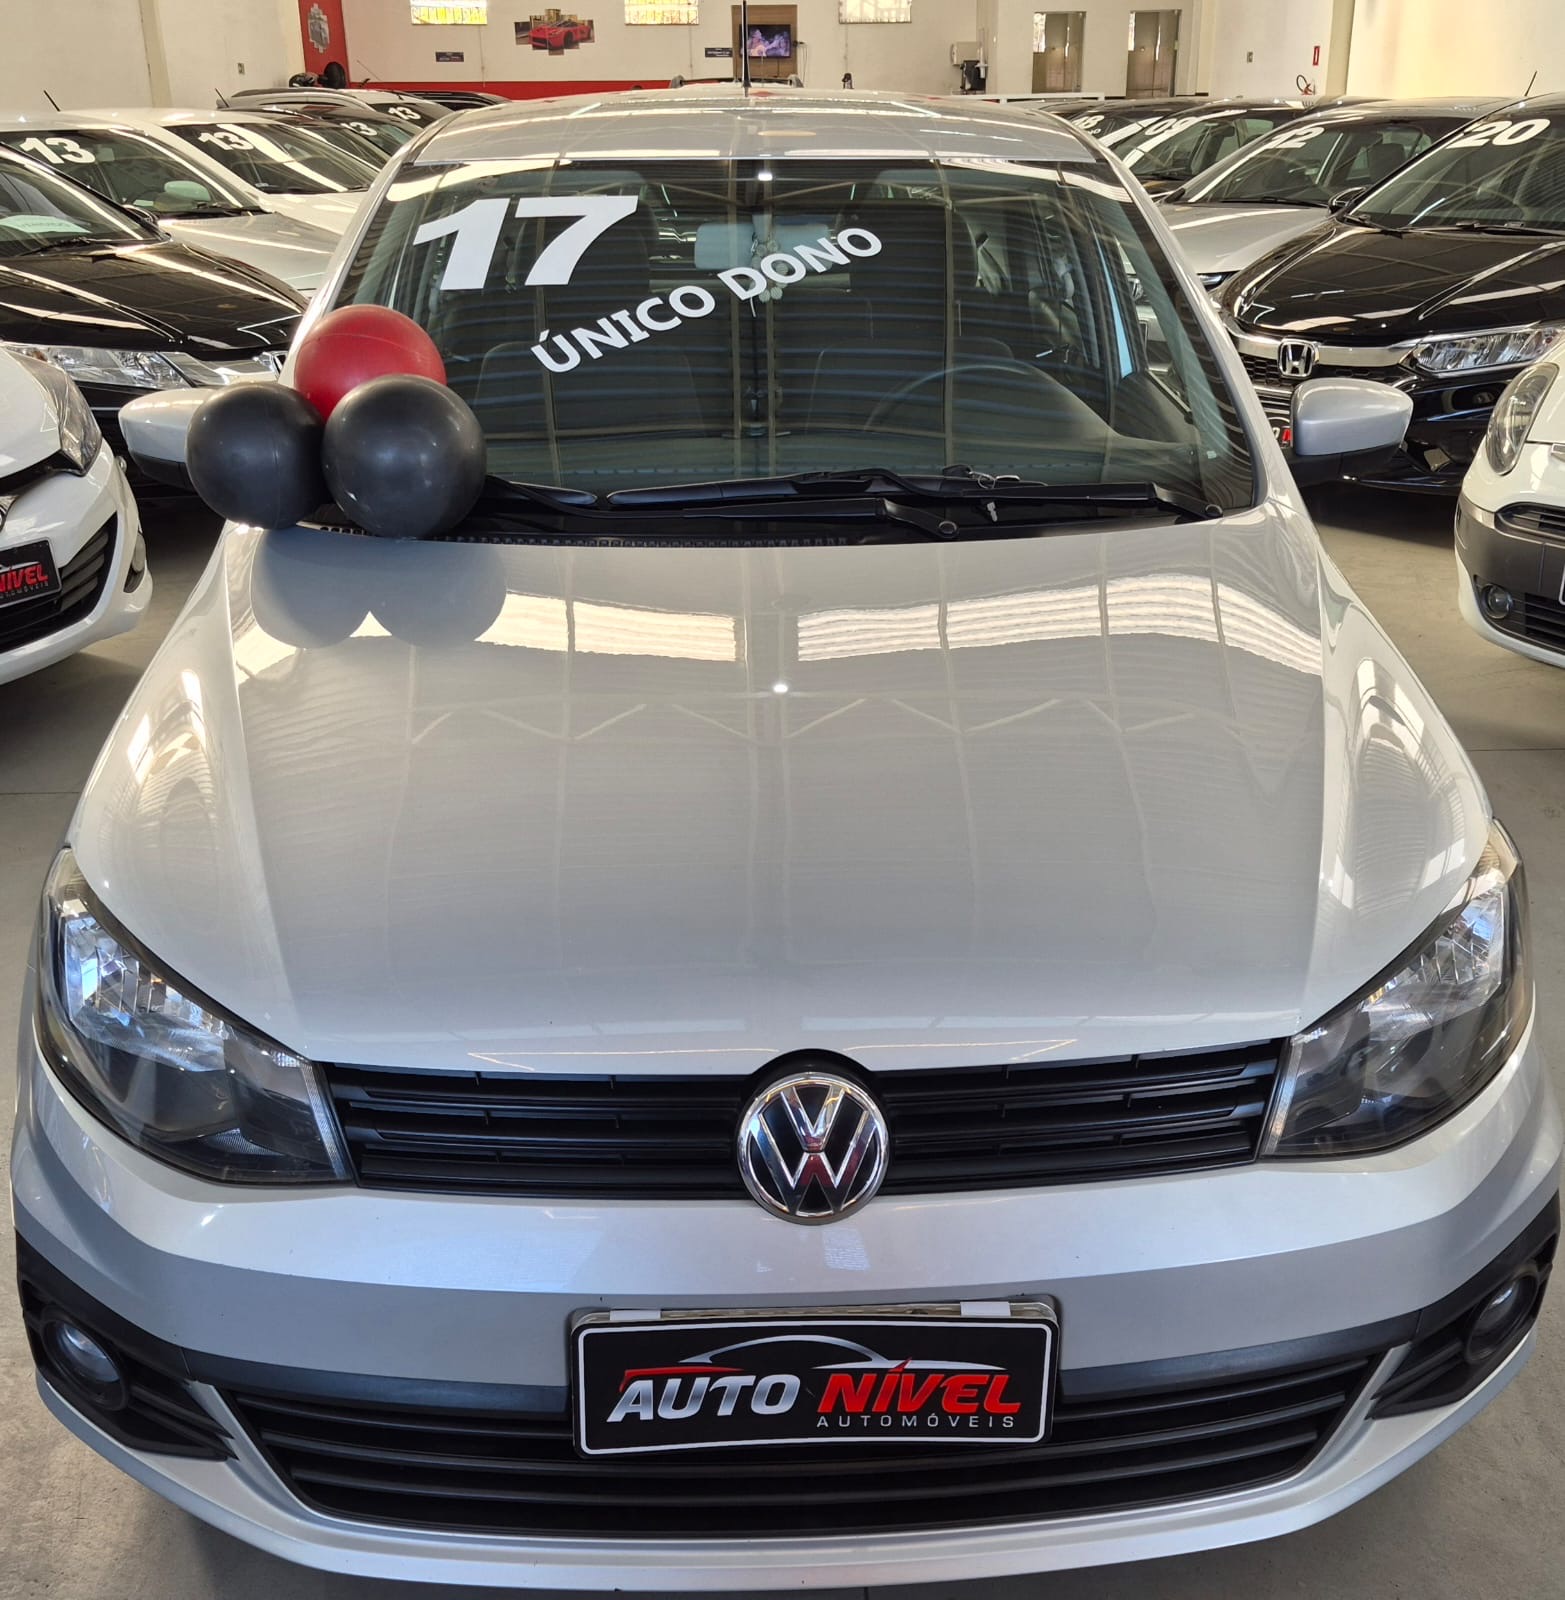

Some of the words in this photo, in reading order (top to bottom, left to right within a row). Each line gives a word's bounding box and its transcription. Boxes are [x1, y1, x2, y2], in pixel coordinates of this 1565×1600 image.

[388, 106, 421, 120] 13
[198, 131, 254, 151] 13
[1445, 118, 1551, 149] 20
[19, 137, 96, 164] 13
[413, 195, 639, 291] 17
[530, 286, 717, 374] ÚNICO
[717, 227, 883, 301] DONO
[606, 1374, 801, 1423] AUTO
[816, 1358, 1022, 1414] NÍVEL
[816, 1413, 1015, 1429] AUTOMÓVEIS
